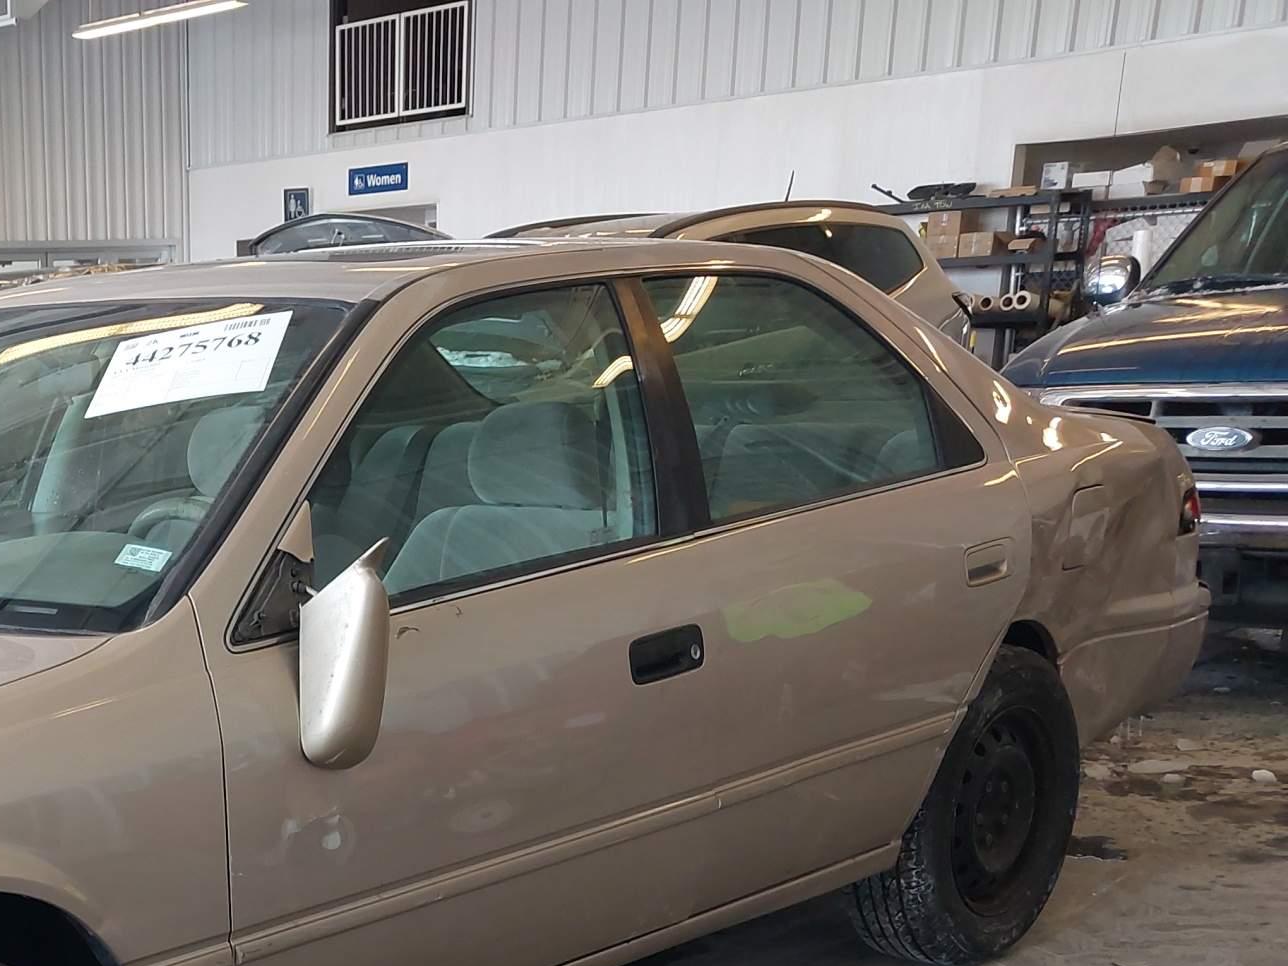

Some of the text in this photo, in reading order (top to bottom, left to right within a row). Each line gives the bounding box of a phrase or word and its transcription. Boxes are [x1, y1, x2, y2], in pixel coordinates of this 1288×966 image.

[366, 174, 402, 188] Women
[125, 331, 262, 366] 44275768
[1200, 431, 1239, 447] Ford
